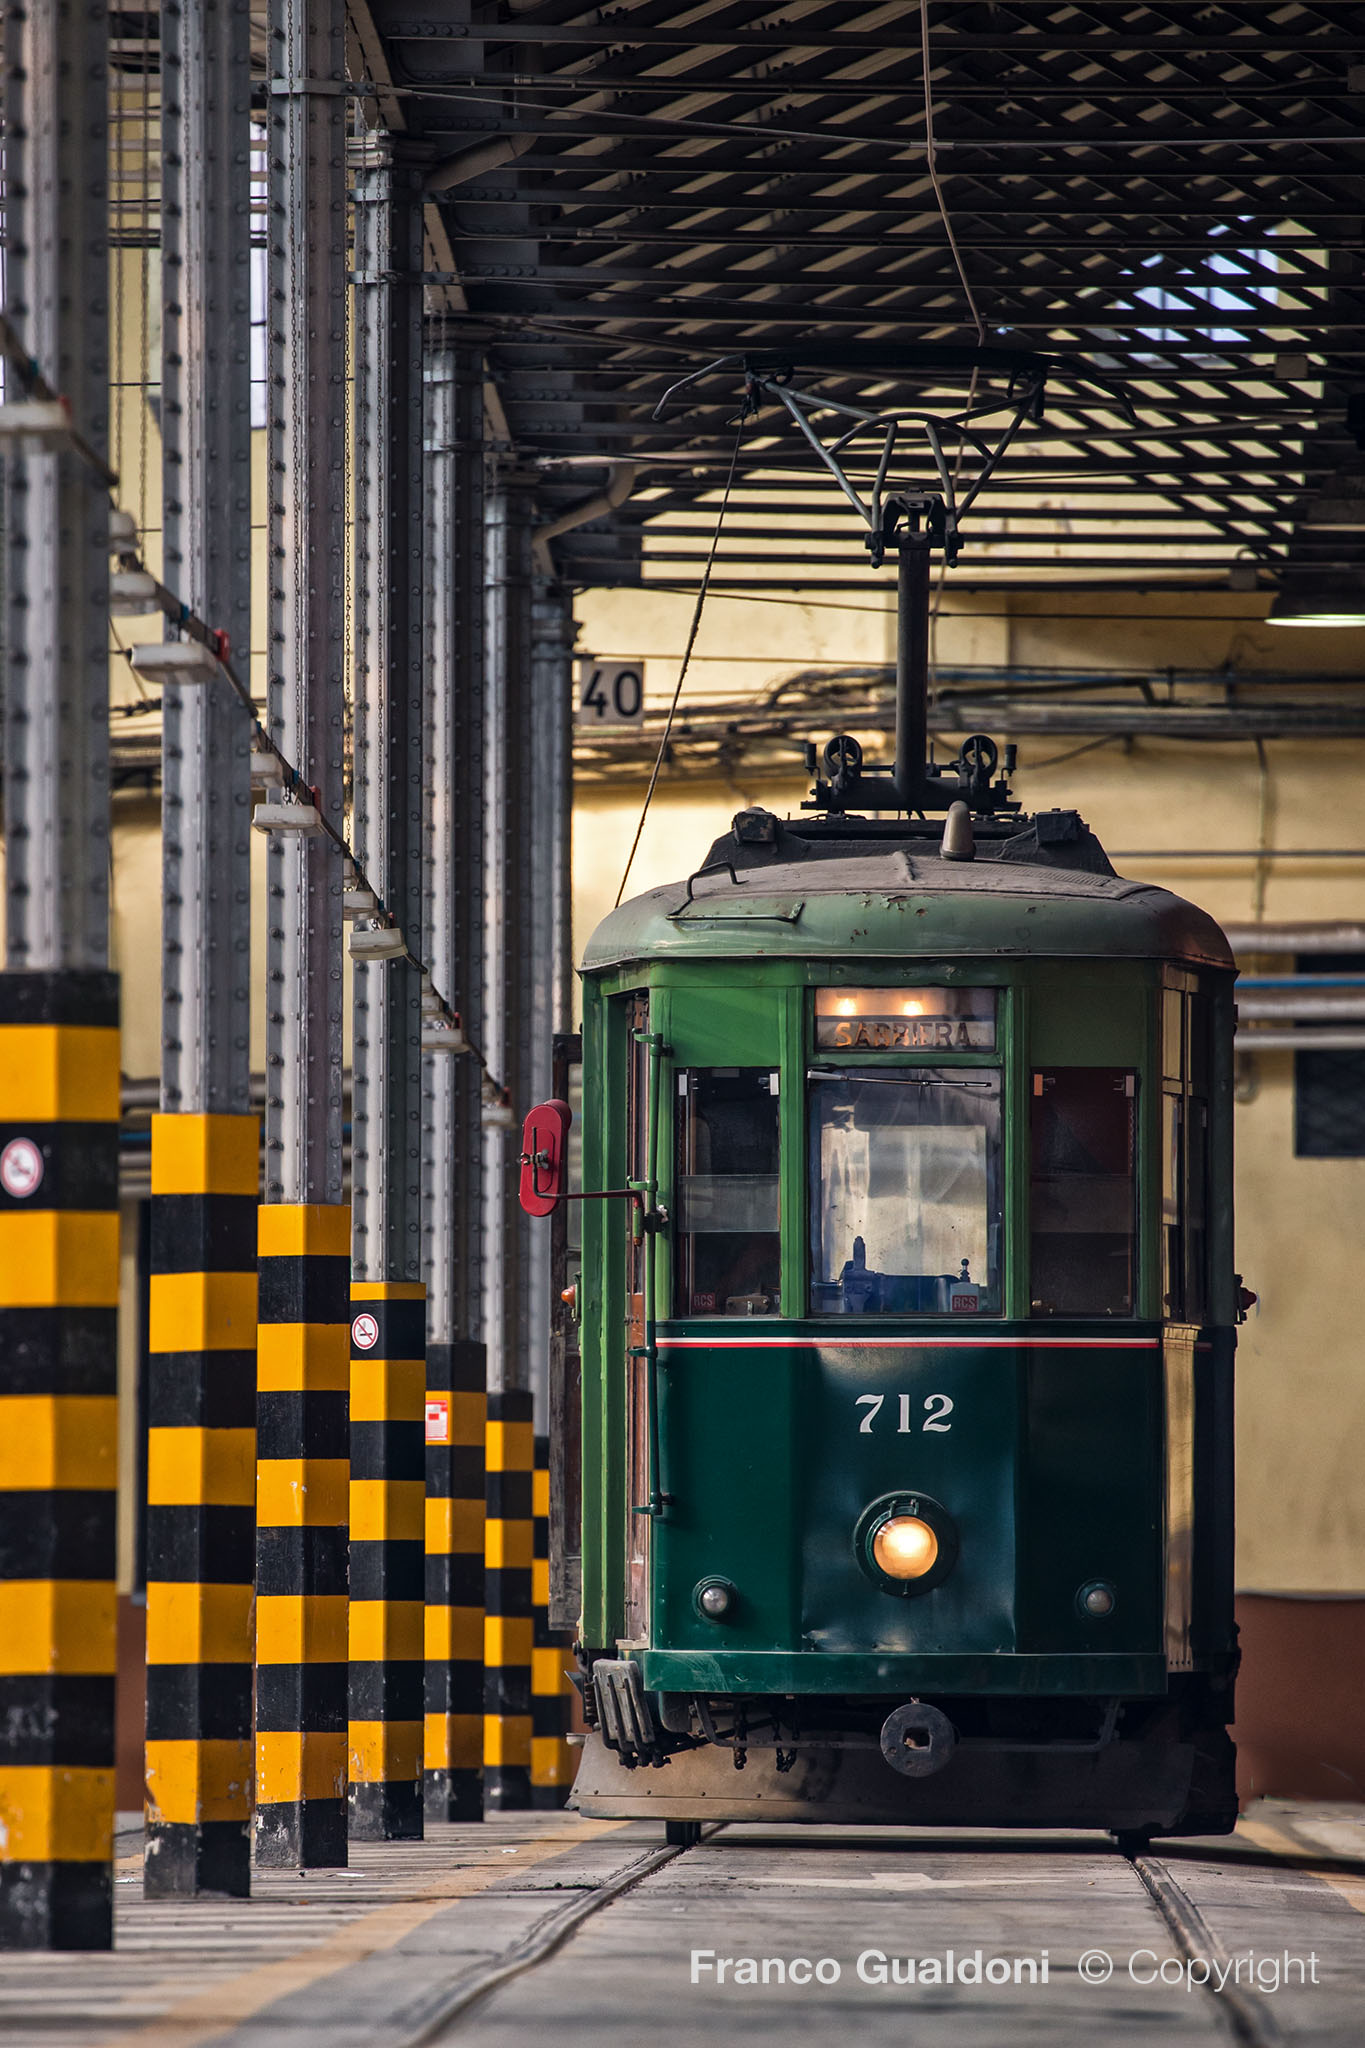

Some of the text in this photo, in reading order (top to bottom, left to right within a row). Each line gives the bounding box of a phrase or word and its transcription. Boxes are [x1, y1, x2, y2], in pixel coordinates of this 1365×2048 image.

[582, 669, 642, 718] 40
[953, 1296, 976, 1309] RCS
[854, 1393, 955, 1433] 712
